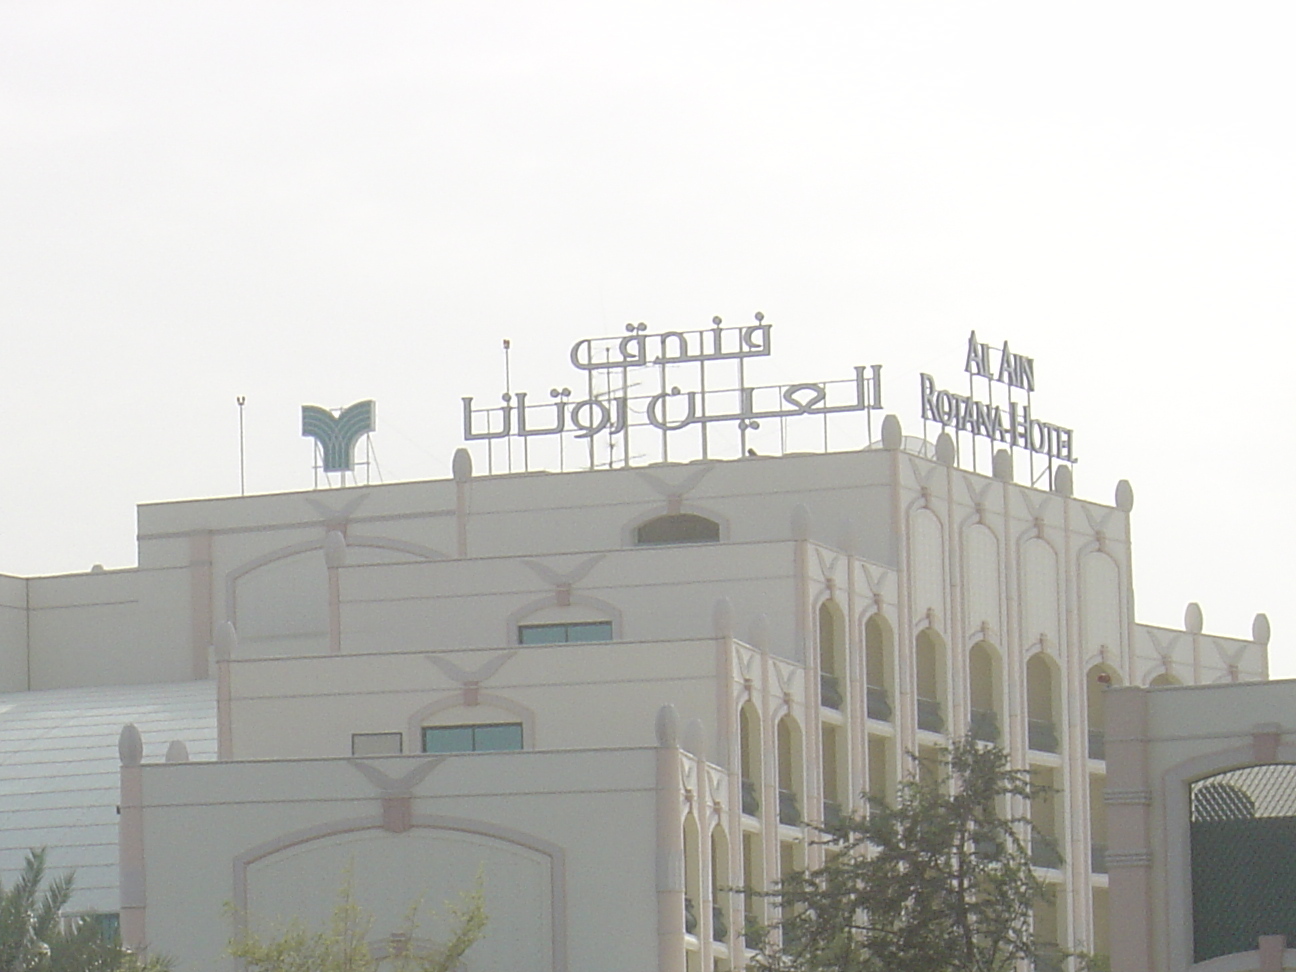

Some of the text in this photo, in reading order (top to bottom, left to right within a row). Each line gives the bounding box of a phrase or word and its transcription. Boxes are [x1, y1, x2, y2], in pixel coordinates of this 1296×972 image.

[570, 311, 773, 370] فندق
[964, 330, 1035, 392] AL AIN
[461, 364, 884, 441] العين روتانا
[920, 372, 1078, 464] ROTANA HOTEL
